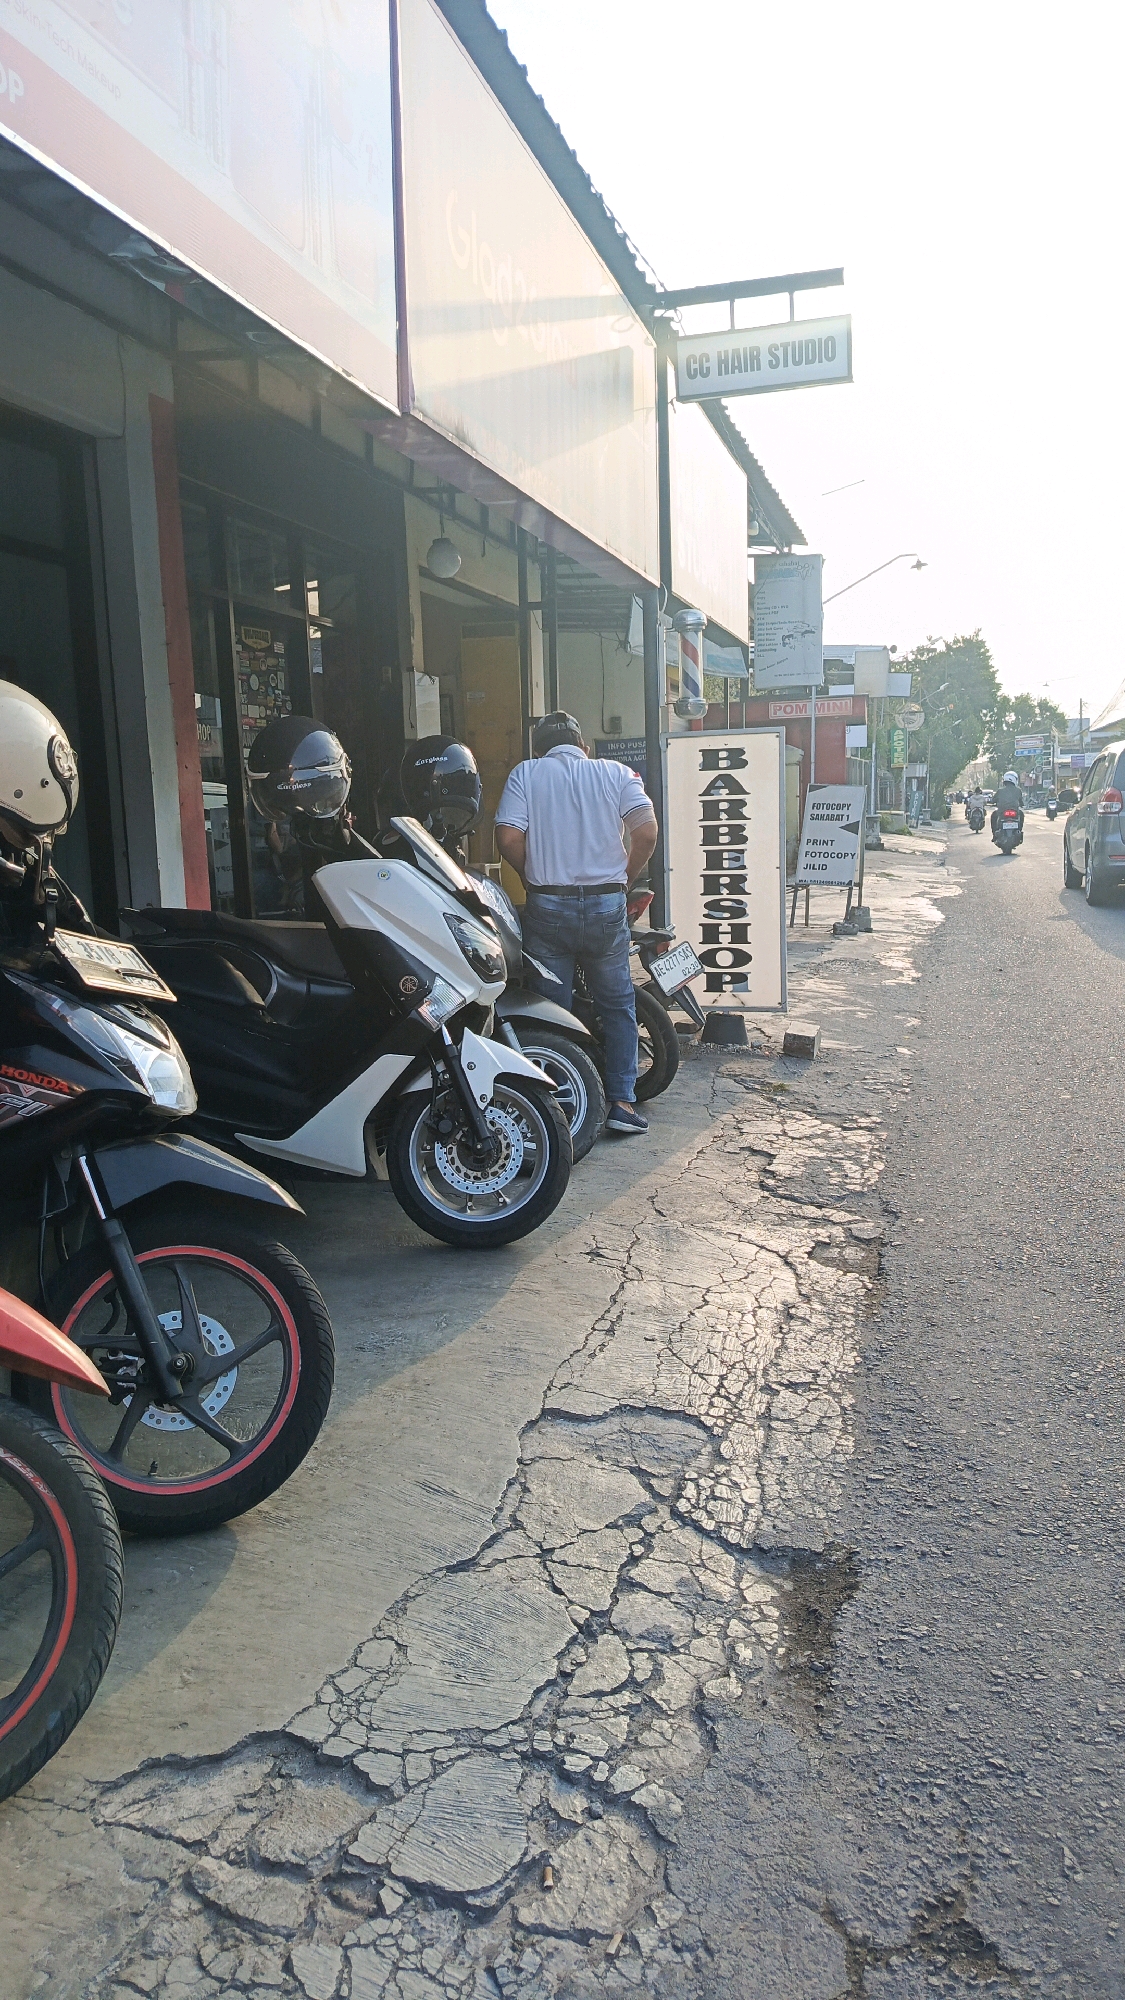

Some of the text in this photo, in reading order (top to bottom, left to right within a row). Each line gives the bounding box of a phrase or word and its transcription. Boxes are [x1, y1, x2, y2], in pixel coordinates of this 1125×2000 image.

[77, 49, 122, 100] Makeup
[685, 335, 837, 380] CC HAIR STUDIO
[773, 701, 850, 716] POM MINI
[608, 742, 625, 750] INFO
[893, 729, 904, 763] APOTEK
[810, 813, 845, 821] SAHABAT
[812, 803, 852, 811] FOTOCOPY
[805, 851, 856, 859] FOTOCOPY
[698, 747, 753, 993] BARBERSHOP
[654, 946, 693, 978] AE 4277 SAS
[0, 1064, 70, 1093] HONDA
